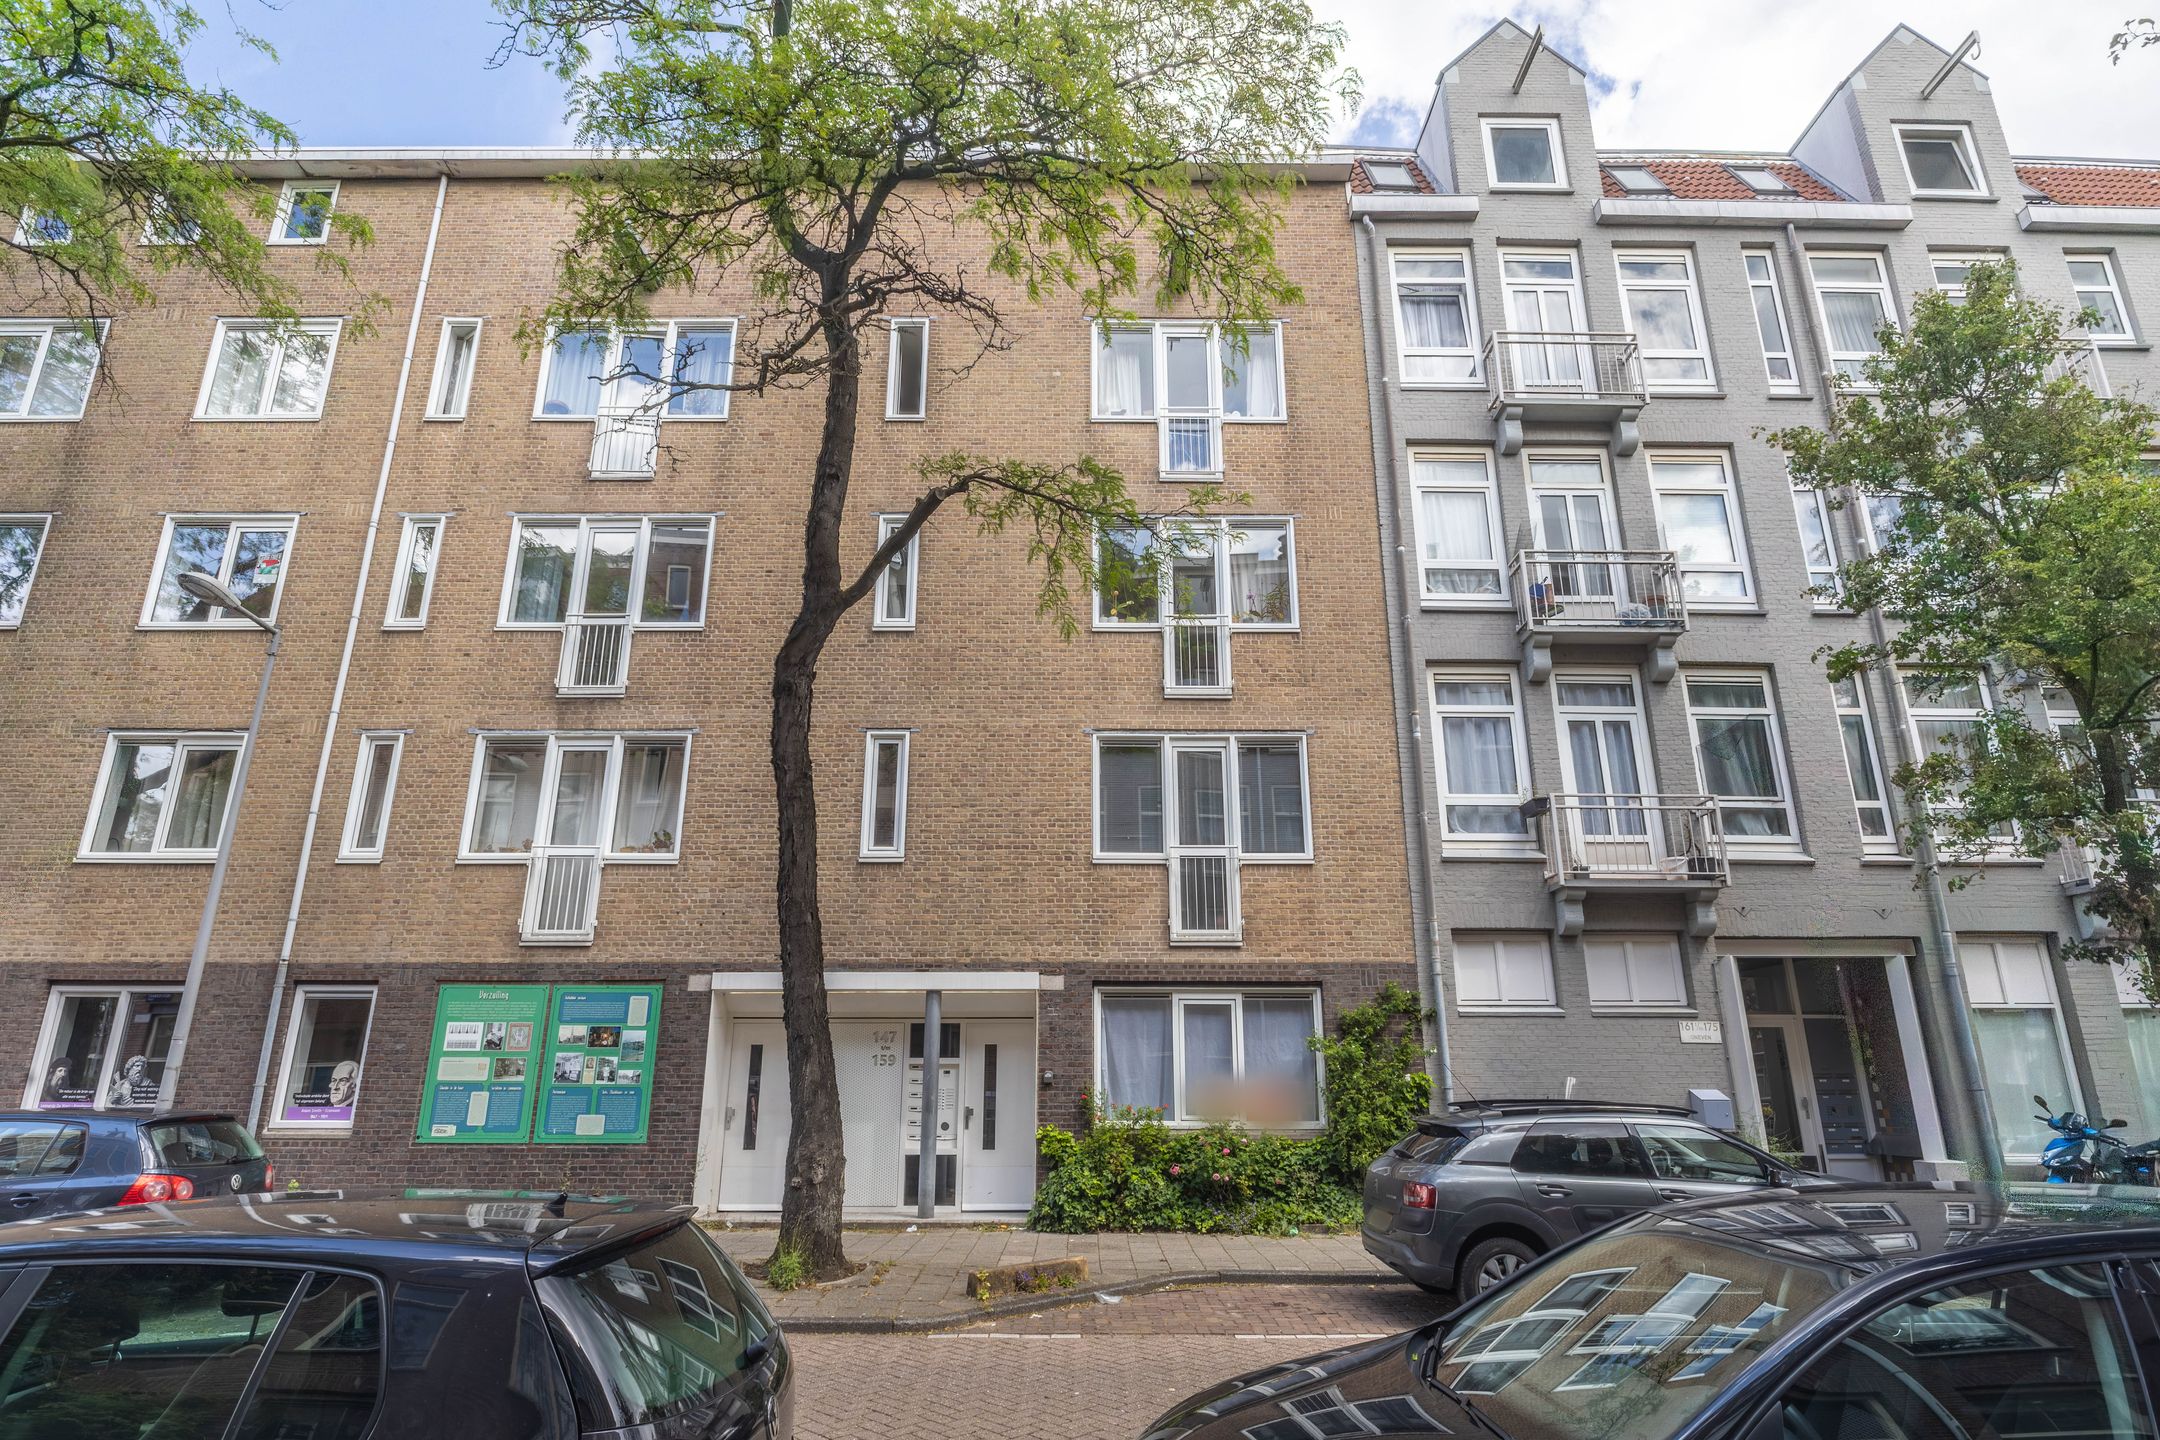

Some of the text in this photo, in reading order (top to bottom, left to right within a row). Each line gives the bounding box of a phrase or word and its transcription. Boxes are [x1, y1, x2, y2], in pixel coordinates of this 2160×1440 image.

[1680, 1022, 1694, 1031] 161
[1703, 1022, 1718, 1032] 175
[872, 1031, 898, 1043] 147
[872, 1054, 896, 1067] 159
